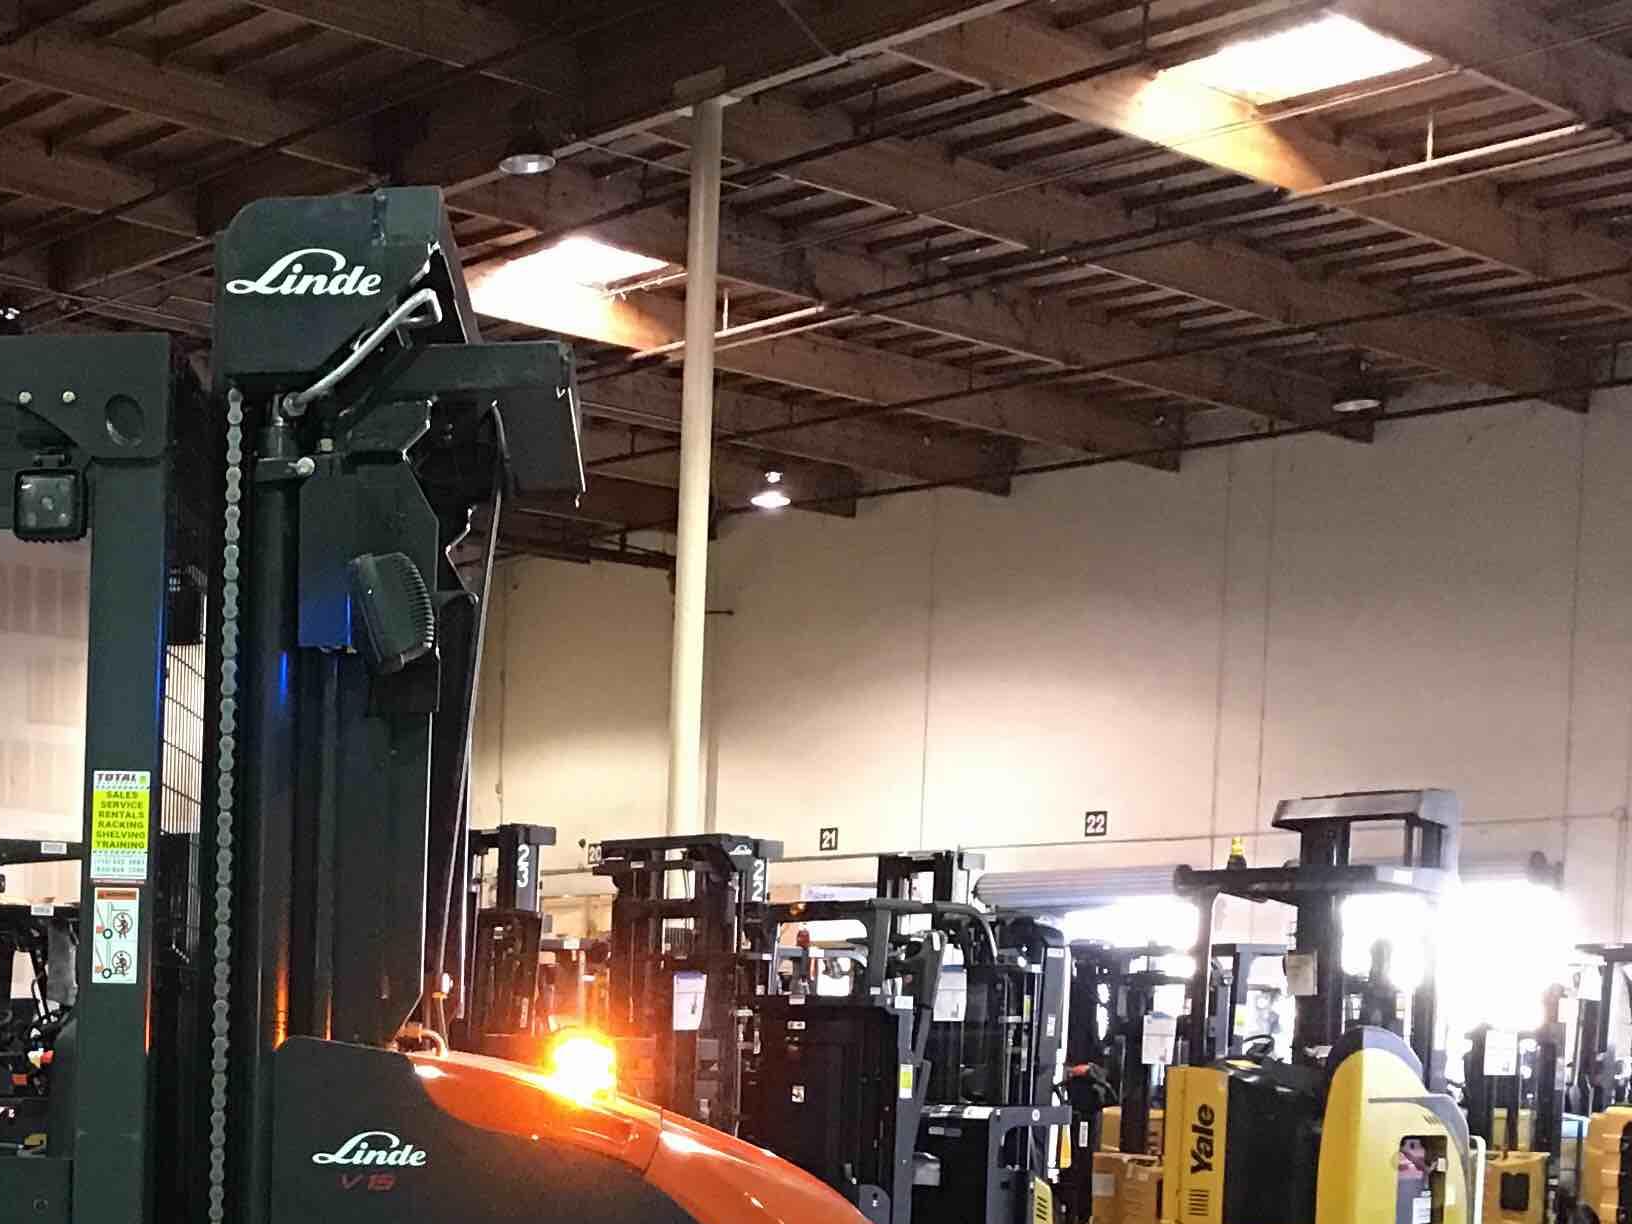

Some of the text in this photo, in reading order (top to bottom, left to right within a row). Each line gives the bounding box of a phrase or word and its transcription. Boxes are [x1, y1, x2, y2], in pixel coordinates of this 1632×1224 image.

[225, 248, 382, 296] Linde
[105, 791, 139, 800] SALES
[100, 801, 144, 809] SERVICE
[98, 810, 145, 819] RENTALS
[1087, 814, 1106, 833] 22
[97, 820, 145, 829] RACKING
[96, 830, 146, 839] SHELVING
[821, 828, 837, 850] 21
[95, 840, 145, 849] TRAINING
[588, 845, 602, 862] 20
[517, 844, 530, 888] 23
[751, 858, 765, 902] 22
[1191, 1104, 1215, 1174] Yale
[311, 1131, 427, 1166] Linde
